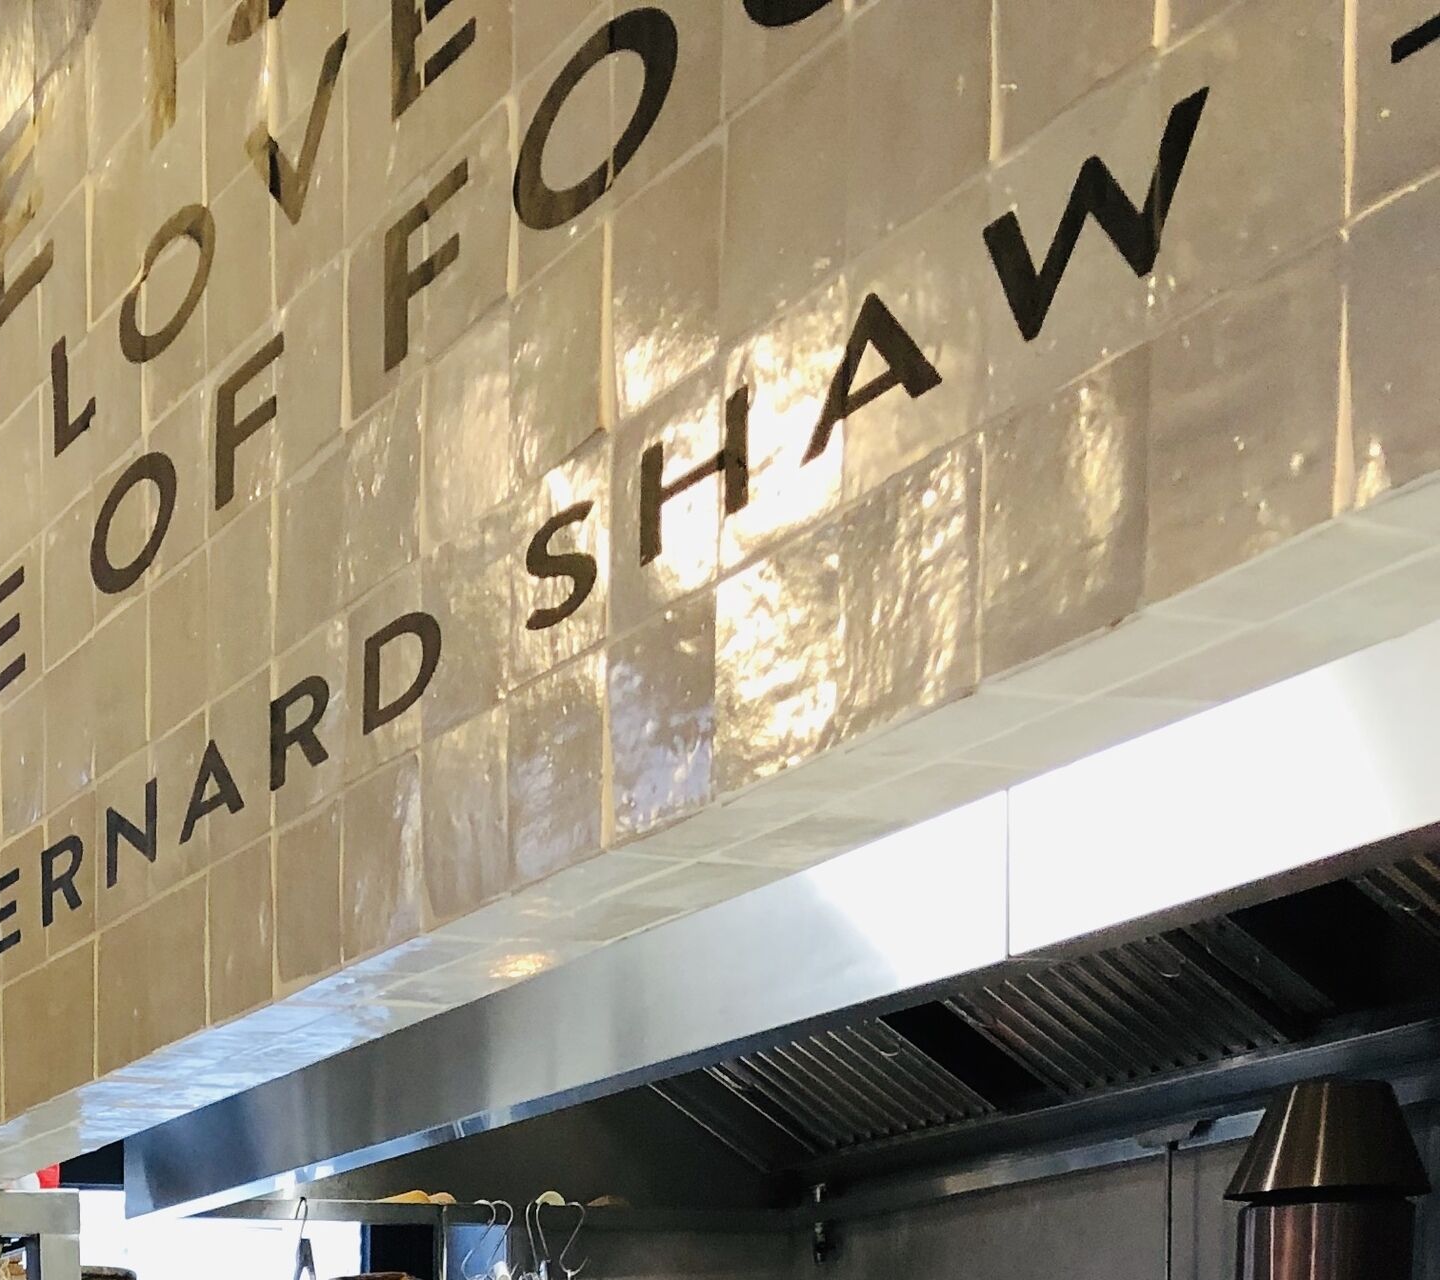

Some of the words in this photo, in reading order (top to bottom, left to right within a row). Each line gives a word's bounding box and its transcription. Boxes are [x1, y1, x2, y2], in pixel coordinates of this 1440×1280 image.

[90, 332, 286, 595] OF
[384, 0, 832, 373] FO
[524, 86, 1210, 631] SHAW
